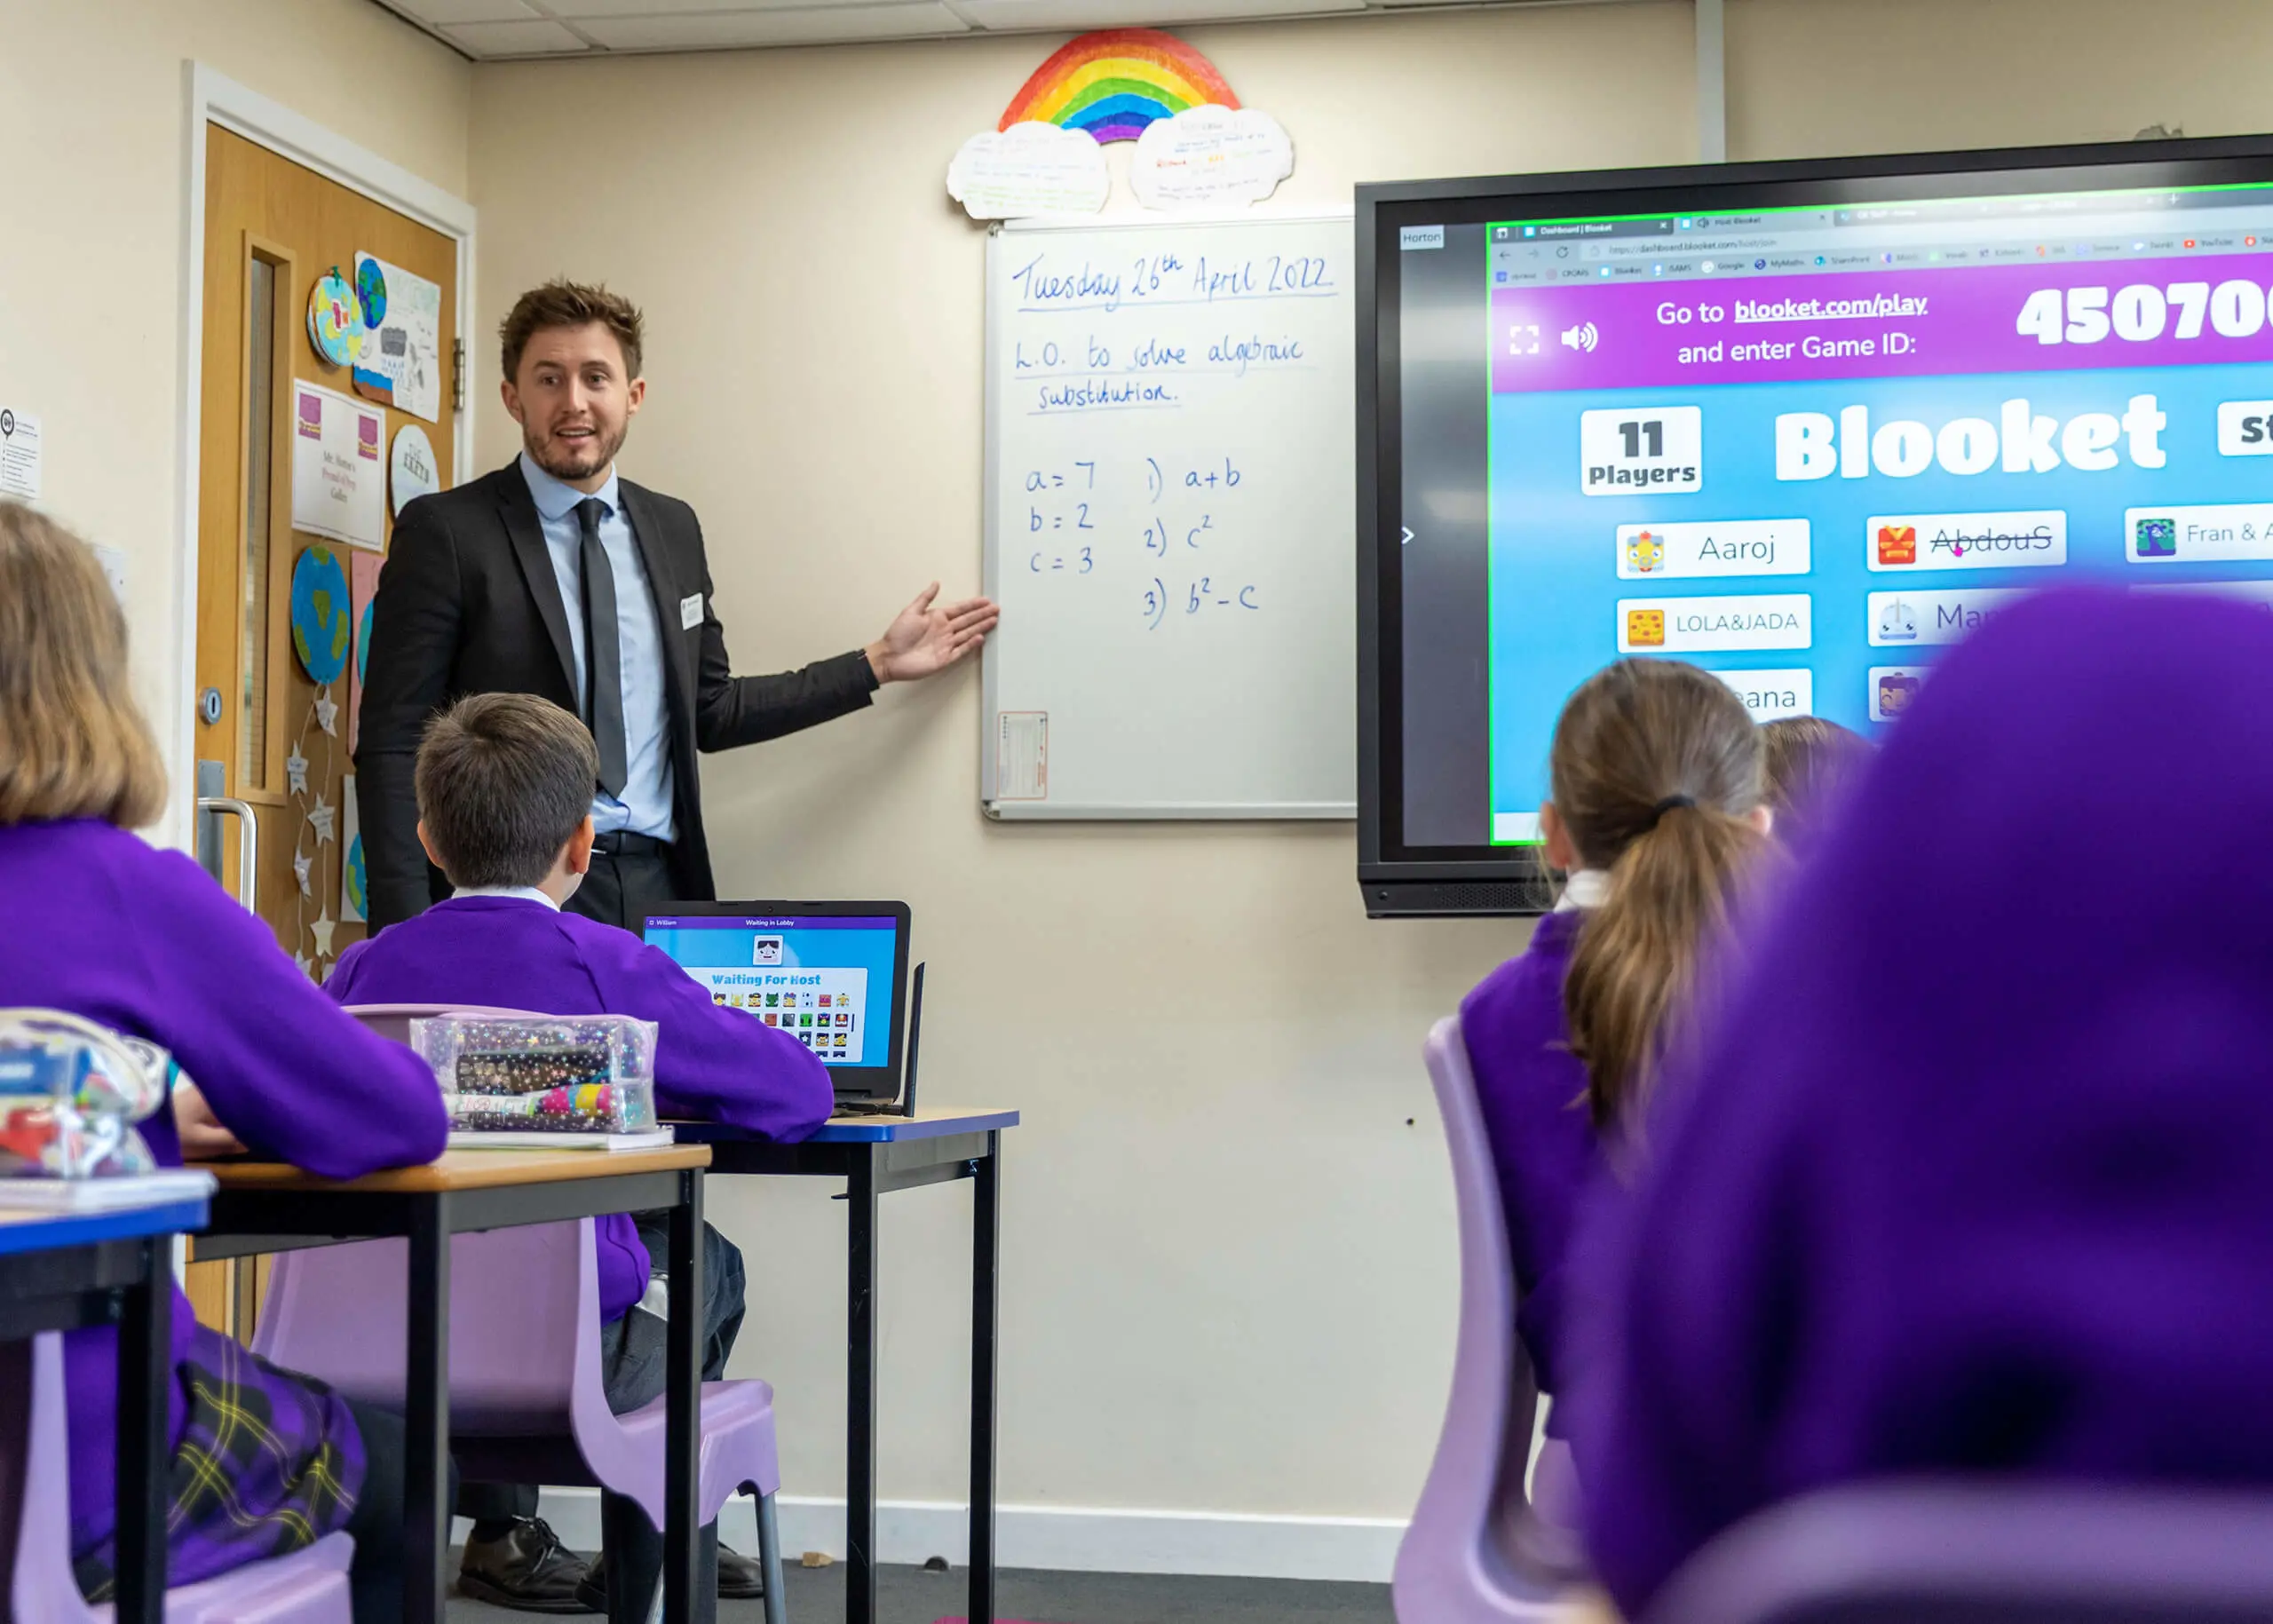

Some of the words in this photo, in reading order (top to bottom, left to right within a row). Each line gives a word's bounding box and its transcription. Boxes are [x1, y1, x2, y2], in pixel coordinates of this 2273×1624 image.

[1013, 253, 1121, 312] Tuesday
[1194, 257, 1257, 302] April
[1268, 256, 1334, 292] 2022
[1656, 302, 1692, 325] Go
[1699, 301, 1725, 324] to
[1734, 293, 1928, 322] blooket.com/play
[2016, 279, 2273, 345] 45070
[1015, 342, 1065, 368] L.O.
[1089, 335, 1111, 368] to
[1126, 338, 1188, 371] solve
[1208, 335, 1304, 378] algebraic
[1677, 341, 1723, 364] and
[1730, 338, 1795, 362] enter
[1802, 336, 1876, 360] Game
[1881, 332, 1916, 356] ID:
[1619, 421, 1663, 458] 11
[1776, 394, 2166, 481] Blooket
[1588, 465, 1696, 487] Players
[1930, 526, 2052, 554] AbdouS
[2187, 524, 2234, 543] Fran
[2241, 522, 2257, 542] &
[1699, 535, 1776, 565] Aaroj
[1676, 611, 1799, 633] LOLA&JADA
[711, 973, 763, 987] Waiting
[764, 974, 788, 986] For
[790, 973, 821, 986] Host
